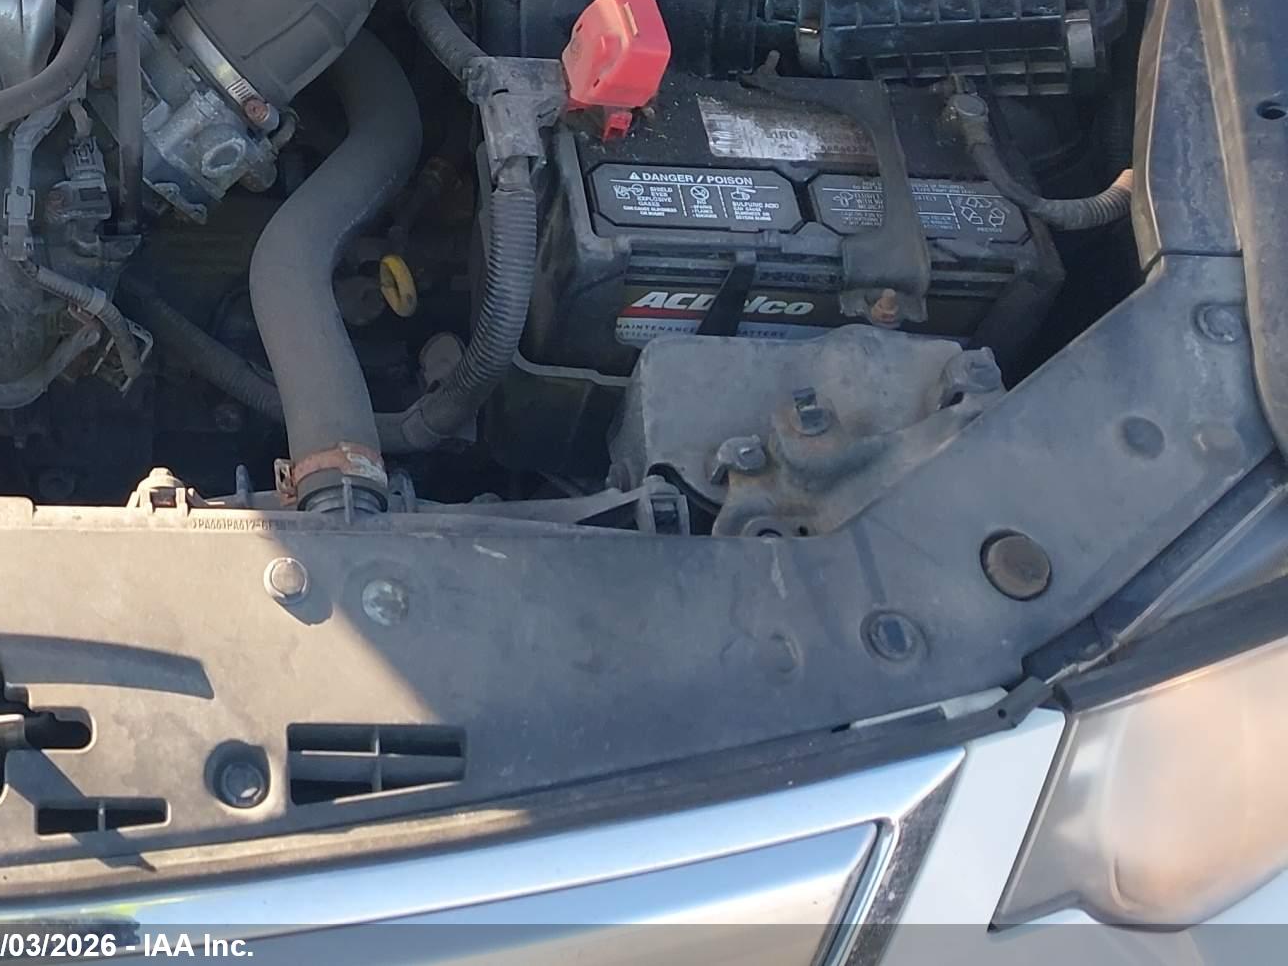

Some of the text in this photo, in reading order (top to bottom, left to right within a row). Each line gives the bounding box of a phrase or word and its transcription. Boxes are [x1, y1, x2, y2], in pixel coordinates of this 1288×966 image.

[642, 172, 694, 183] DANGER
[706, 175, 753, 186] POISON
[630, 290, 815, 315] ACDlco
